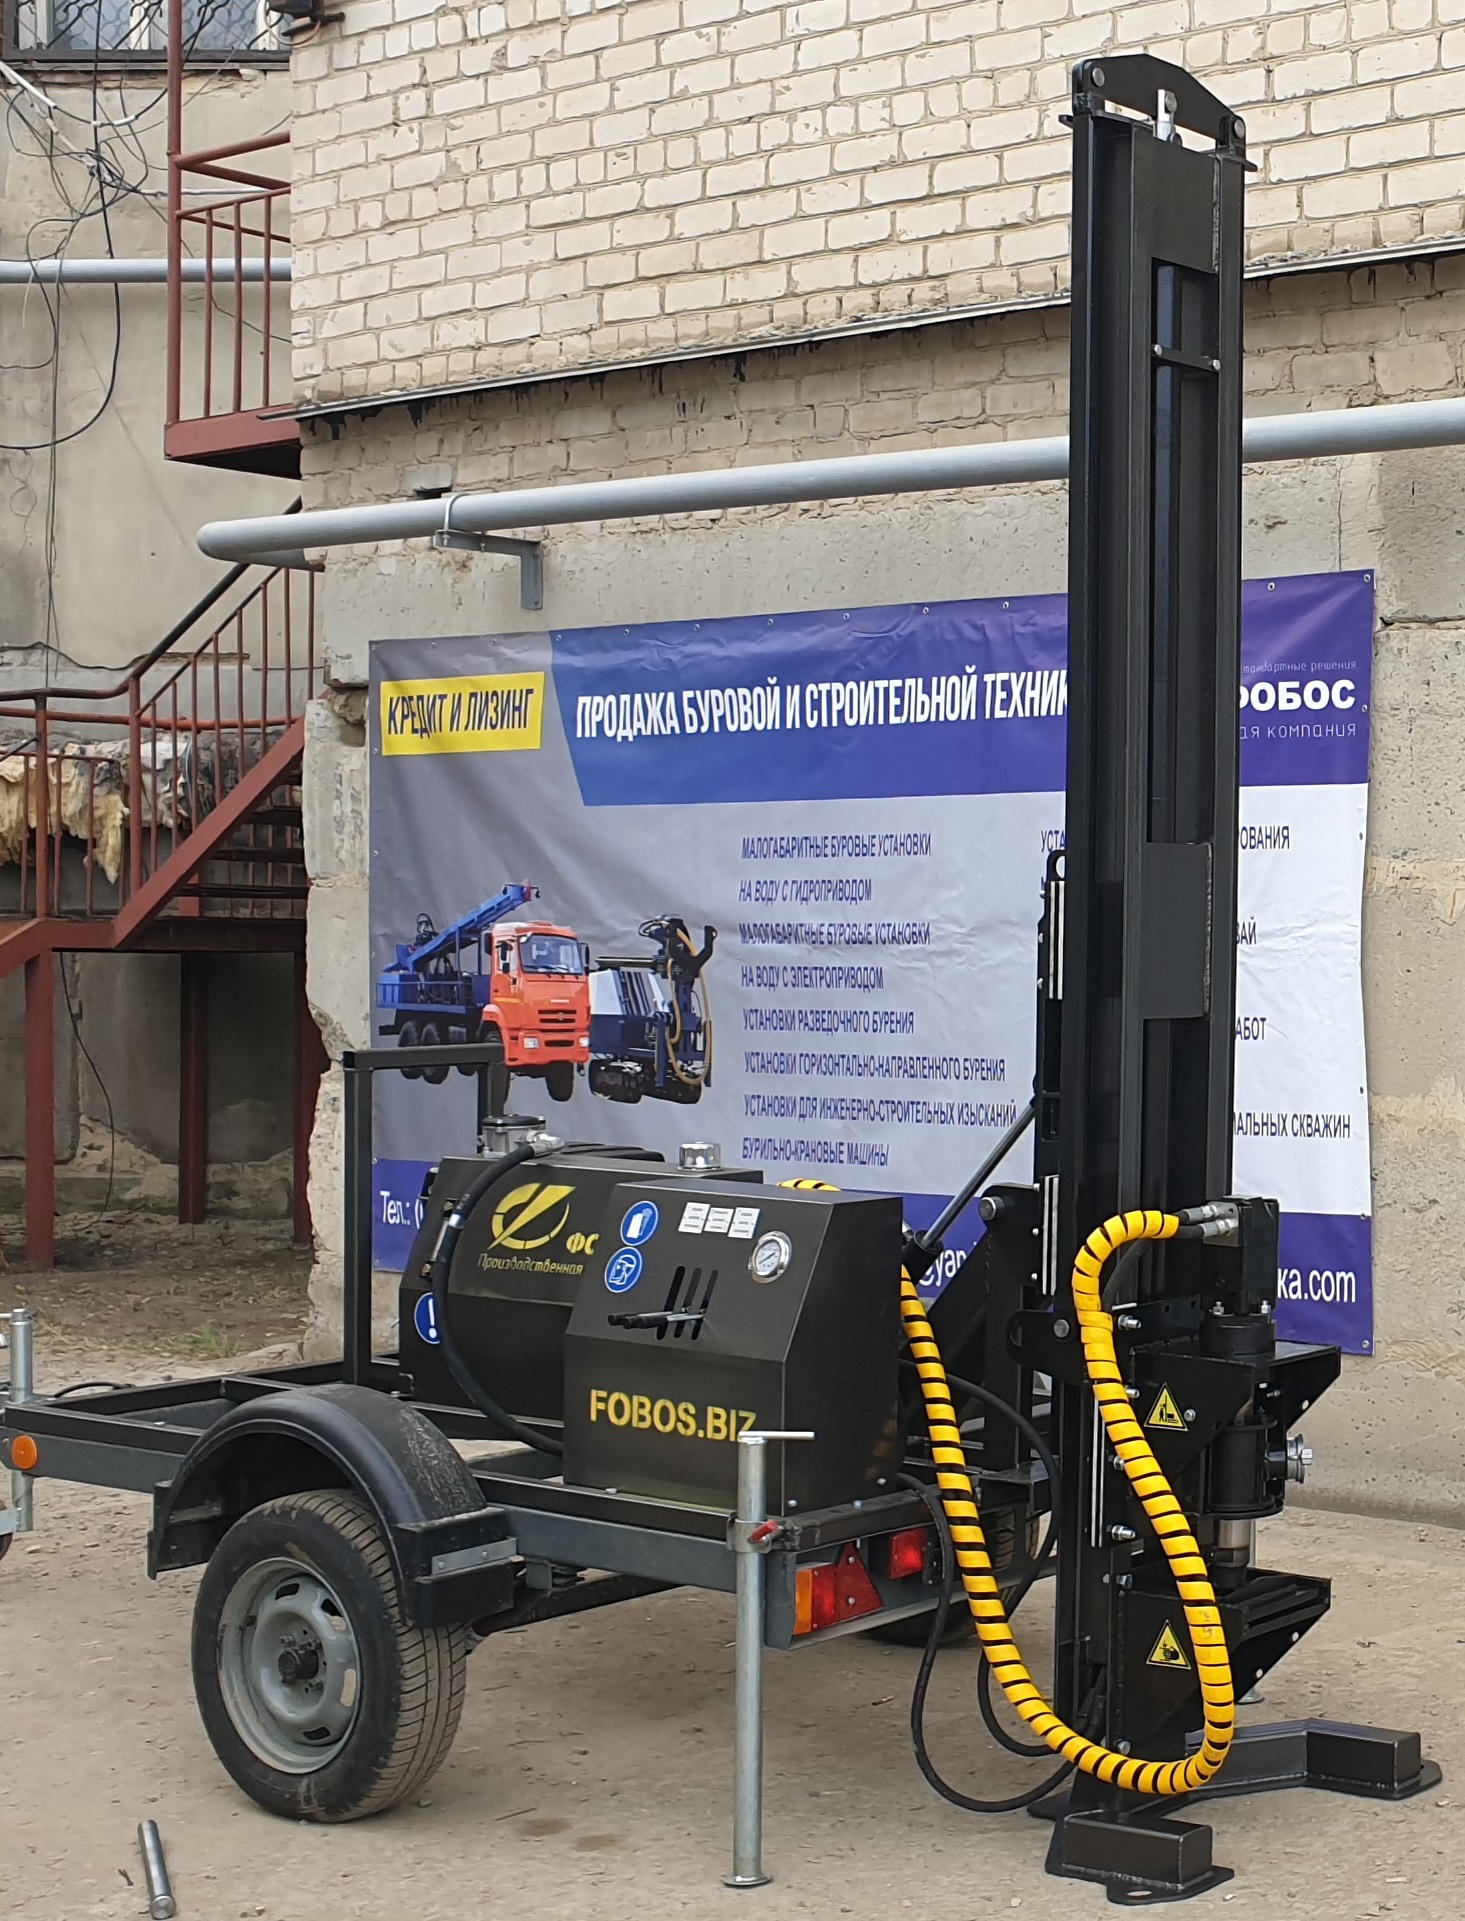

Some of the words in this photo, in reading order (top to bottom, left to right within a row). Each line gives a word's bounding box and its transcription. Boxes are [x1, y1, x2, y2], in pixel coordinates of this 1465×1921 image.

[1242, 661, 1307, 675] тандартные
[1311, 660, 1357, 673] решения
[387, 692, 448, 739] КРЕДИТ
[449, 691, 464, 733] И
[464, 688, 536, 732] ЛИЗИНГ
[576, 691, 681, 742] ПРОДАЖА
[685, 676, 781, 735] БУРОВОЙ
[786, 684, 800, 730] И
[805, 664, 978, 728] СТРОИТЕЛЬНОЙ
[984, 669, 1067, 719] ТЕХНИК
[1240, 725, 1260, 740] ая
[1267, 723, 1357, 739] компания
[742, 836, 829, 859] МАЛОГАБАРИТНЫЕ
[830, 835, 876, 858] БУРОВЫЕ
[878, 833, 931, 856] УСТАНОВКИ
[1041, 829, 1066, 853] УСТА
[1240, 825, 1290, 850] ОВАНИЯ
[739, 880, 752, 901] НА
[755, 880, 780, 906] ВОДУ
[782, 880, 789, 902] С
[790, 879, 872, 906] ГИДРОПРИВОДОМ
[739, 923, 825, 945] МАЛОГАБАРИТНЫЕ
[826, 923, 873, 945] БУРОВЫЕ
[875, 922, 931, 945] УСТАНОВКИ
[741, 965, 754, 987] НА
[756, 966, 780, 992] ВОДУ
[782, 967, 789, 988] С
[791, 966, 884, 993] ЭЛЕКТРОПРИВОДОМ
[743, 1008, 796, 1031] УСТАНОВКИ
[798, 1010, 870, 1036] РАЗВЕДОЧНОГО
[872, 1011, 914, 1034] БУРЕНИЯ
[1235, 1017, 1266, 1040] АБОТ
[744, 1052, 797, 1075] УСТАНОВКИ
[799, 1053, 960, 1080] ГОРИЗОНТАЛЬНО-НАПРАВЛЕННОГО
[963, 1058, 1005, 1082] БУРЕНИЯ
[744, 1094, 797, 1117] УСТАНОВКИ
[797, 1096, 818, 1123] ДЛЯ
[820, 1097, 955, 1125] ИНЖЕНЕРНО-СТРОИТЕЛЬНЫХ
[957, 1099, 1016, 1127] ИЗЫСКАНИЙ
[1232, 1112, 1288, 1137] АЛЬНЫХ
[1291, 1113, 1350, 1139] СКВАЖИН
[742, 1137, 844, 1164] БУРИЛЬНО-КРАНОВЫЕ
[847, 1142, 889, 1166] МАШИНЫ
[477, 1252, 584, 1275] Производственная
[590, 1388, 757, 1442] FOBOS.BIZ
